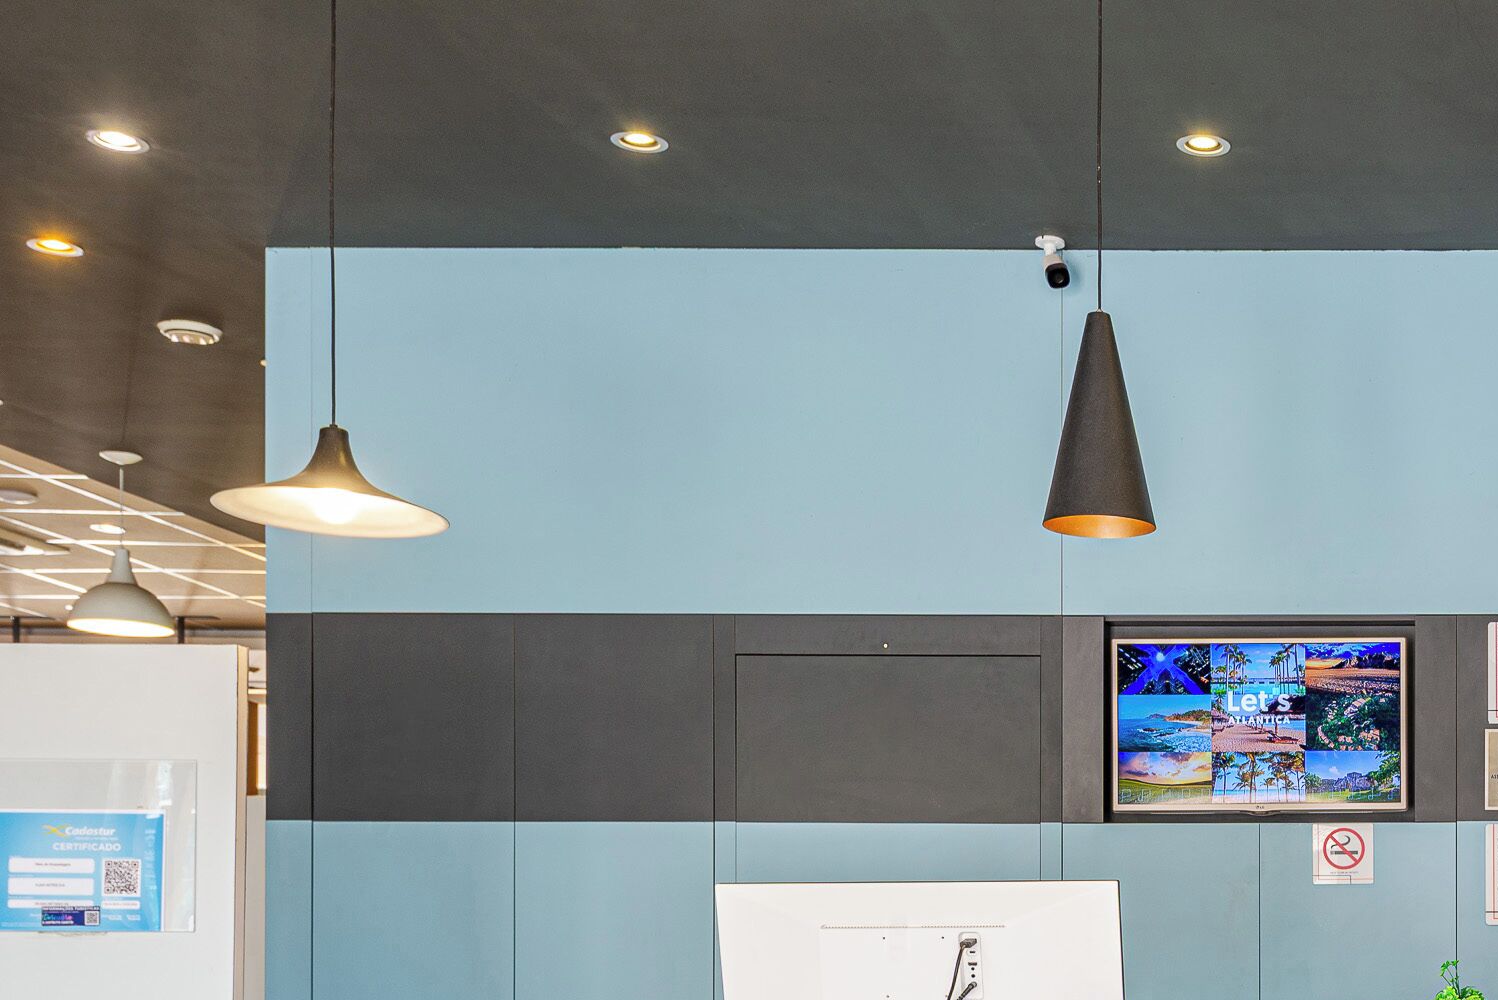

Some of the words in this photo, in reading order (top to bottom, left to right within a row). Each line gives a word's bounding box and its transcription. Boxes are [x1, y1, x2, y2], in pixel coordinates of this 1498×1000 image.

[1228, 688, 1291, 712] Let's
[1228, 716, 1291, 724] ATLANTICA
[65, 827, 116, 835] Cadastur
[53, 843, 121, 851] CERTIFICADO
